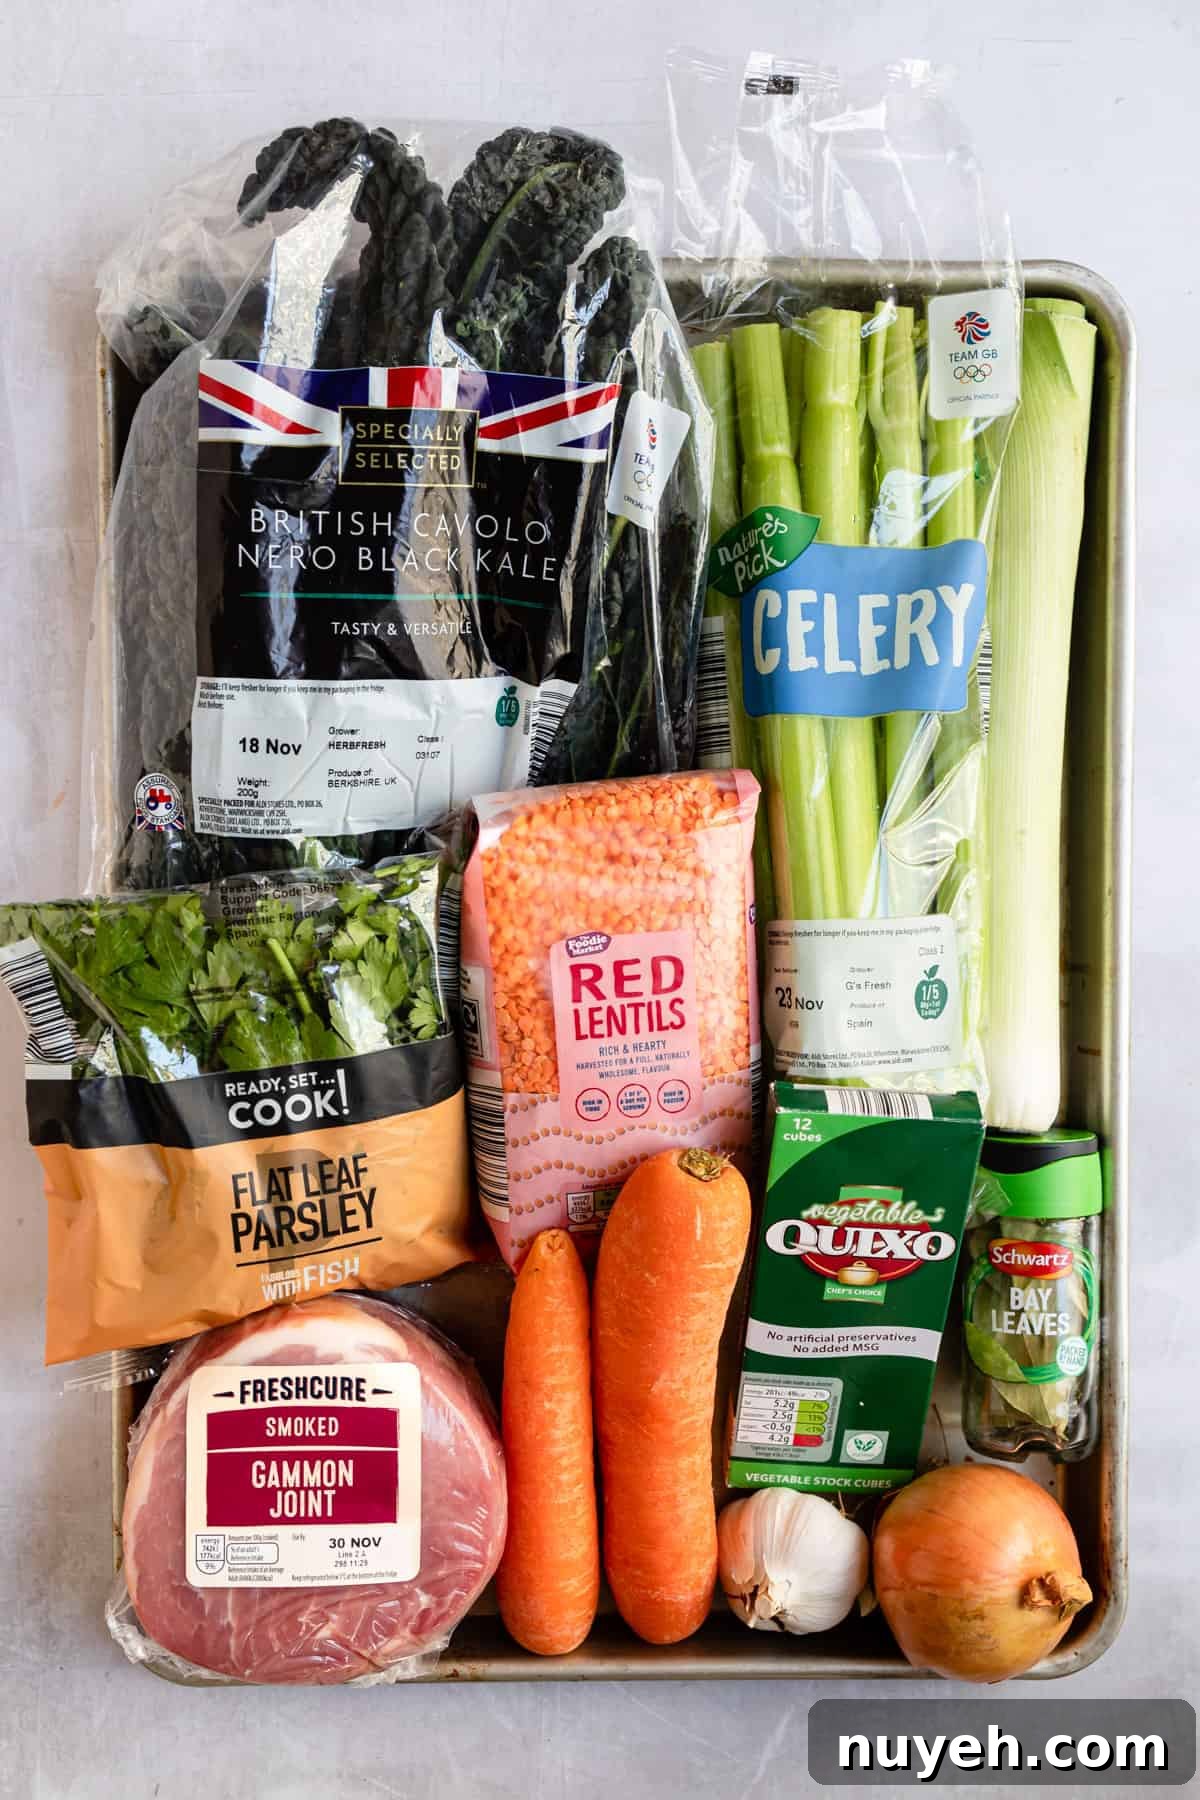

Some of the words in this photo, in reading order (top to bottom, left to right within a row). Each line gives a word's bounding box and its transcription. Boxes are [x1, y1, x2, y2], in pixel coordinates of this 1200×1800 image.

[949, 349, 978, 363] TEAM
[981, 349, 998, 359] GB
[354, 422, 463, 442] SPECIALLY
[354, 452, 461, 470] SELECTED
[250, 508, 393, 537] BRITISH
[413, 511, 549, 545] CAVOLO
[237, 543, 337, 570] NERO
[358, 546, 460, 573] BLACK
[475, 547, 558, 582] KALE
[330, 621, 381, 635] TASTY
[387, 622, 398, 634] &
[403, 620, 473, 636] VERSATILE
[753, 583, 976, 677] CELERY
[328, 726, 360, 736] Grower:
[239, 737, 260, 754] 18
[266, 738, 302, 756] Nov
[328, 769, 361, 777] Produce
[384, 777, 398, 786] UK
[237, 776, 271, 789] Weight:
[237, 788, 259, 799] 200g
[568, 955, 685, 1003] RED
[845, 981, 862, 992] G's
[864, 981, 892, 991] Fresh
[775, 987, 792, 1009] 23
[794, 997, 824, 1011] Nov
[922, 984, 940, 1001] 1/5
[572, 997, 686, 1041] LENTILS
[847, 1019, 873, 1031] Spain
[599, 1045, 619, 1057] RICH
[622, 1044, 629, 1054] &
[632, 1040, 667, 1052] HEARTY
[576, 1059, 613, 1071] HARVESTED
[642, 1064, 670, 1073] FLAVOUR
[225, 1077, 287, 1098] READY,
[288, 1071, 336, 1090] SET...
[228, 1068, 351, 1129] COOK!
[793, 1117, 812, 1131] 12
[783, 1131, 822, 1144] cubes
[232, 1165, 295, 1210] FLAT
[302, 1152, 369, 1199] LEAF
[231, 1187, 377, 1253] PARSLEY
[765, 1219, 957, 1262] QUIXO
[991, 1246, 1070, 1267] Schwartz
[261, 1278, 303, 1302] WITH
[302, 1256, 361, 1292] FISH
[1009, 1287, 1053, 1311] BAY
[991, 1309, 1071, 1337] LEAVES
[767, 1329, 784, 1342] No
[786, 1330, 835, 1344] artificial
[836, 1332, 918, 1346] preservatives
[792, 1343, 807, 1354] No
[808, 1343, 849, 1354] added
[852, 1343, 880, 1353] MSG
[239, 1375, 367, 1405] FRESHCURE
[773, 1399, 795, 1410] 5.2g
[772, 1410, 793, 1421] 2.5g
[265, 1416, 340, 1437] SMOKED
[762, 1422, 791, 1433] <0.5g
[768, 1434, 790, 1445] 4.2g
[251, 1459, 354, 1489] GAMMON
[745, 1471, 812, 1486] VEGETABLE
[813, 1474, 853, 1488] STOCK
[855, 1477, 892, 1490] CUBES
[269, 1489, 336, 1518] JOINT
[328, 1538, 346, 1549] 30
[351, 1537, 382, 1548] NOV
